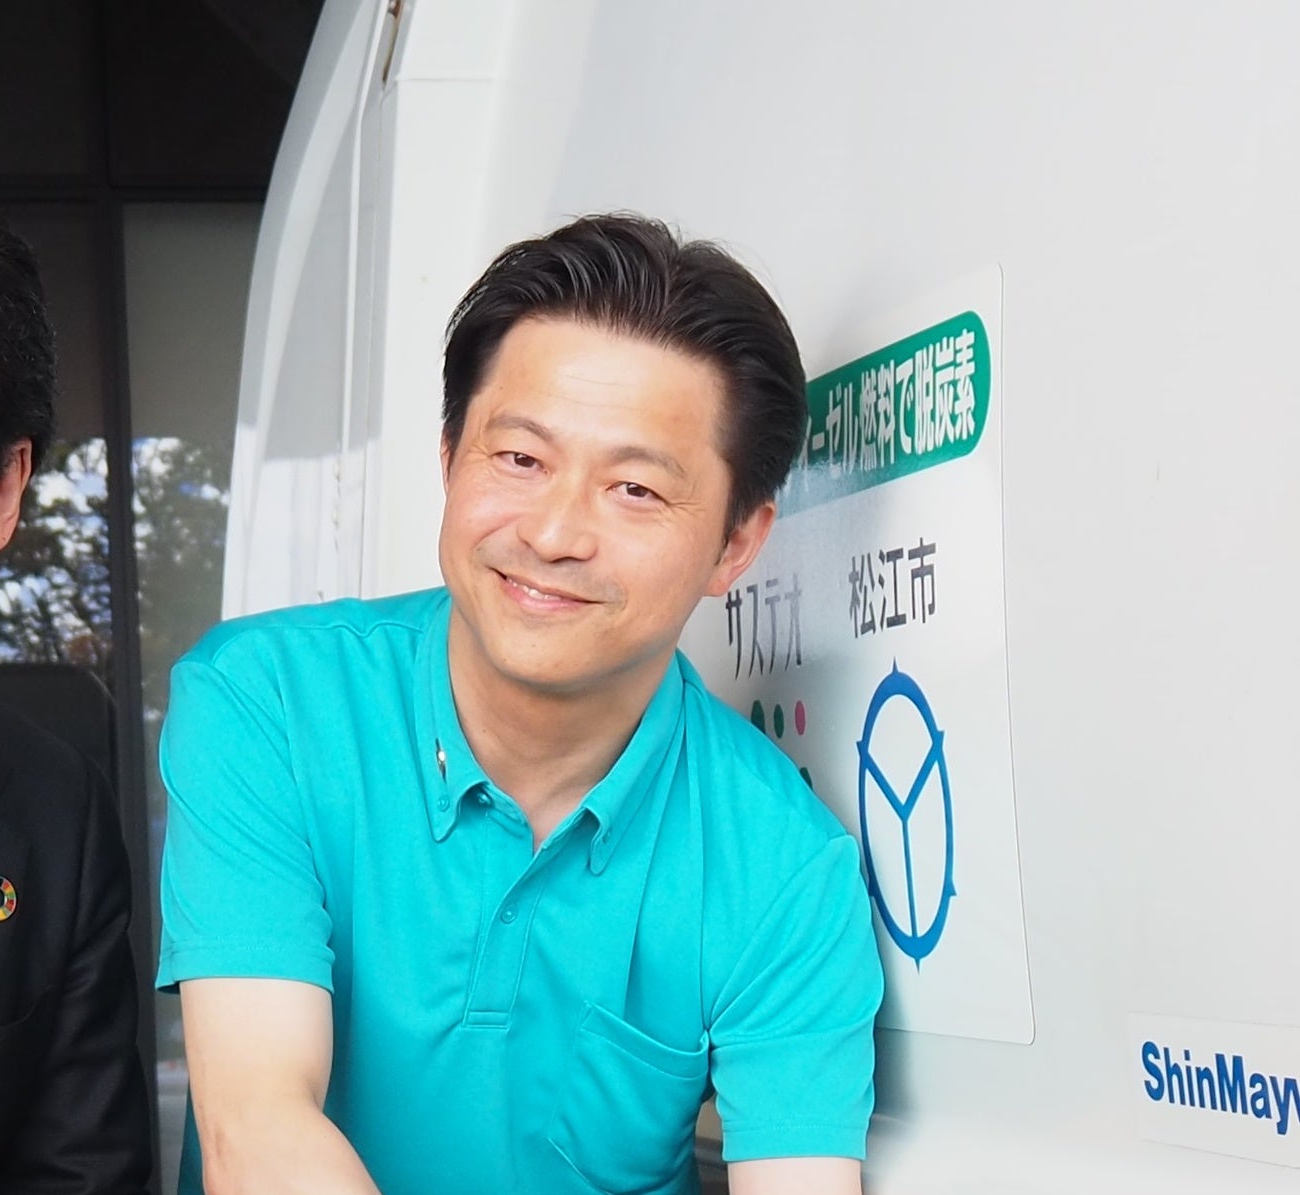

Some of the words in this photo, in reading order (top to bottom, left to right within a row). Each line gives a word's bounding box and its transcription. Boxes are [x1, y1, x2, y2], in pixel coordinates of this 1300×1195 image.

[784, 329, 975, 496] ィーゼル燃料で脱炭素
[726, 573, 802, 681] サステオ
[849, 537, 936, 638] 松江市
